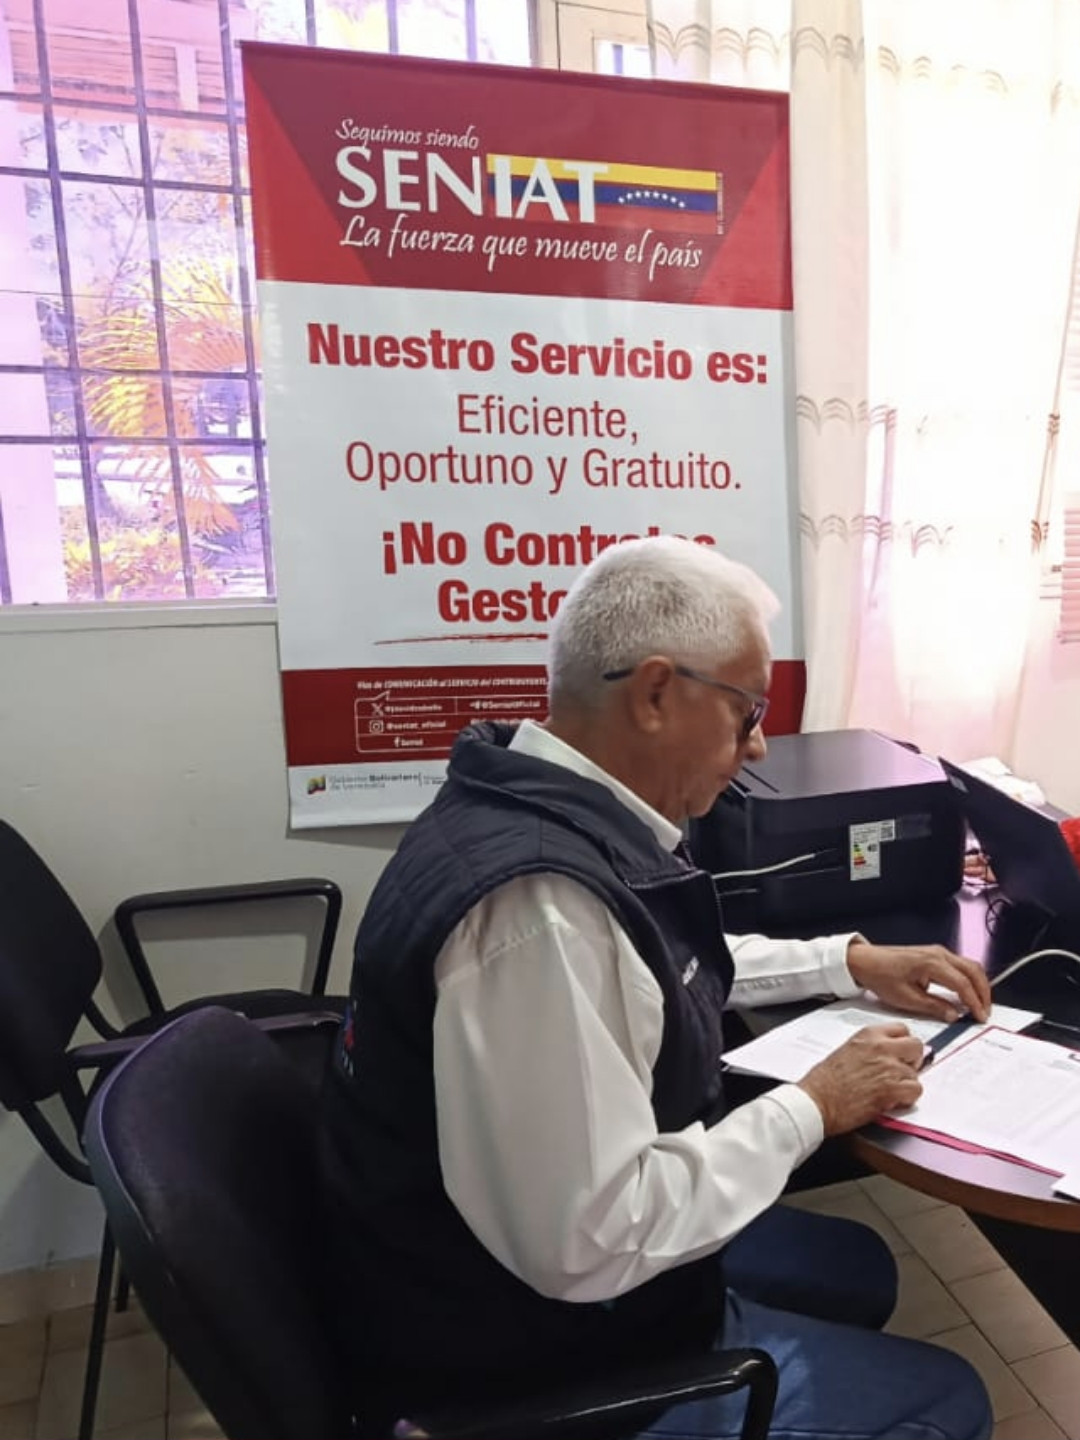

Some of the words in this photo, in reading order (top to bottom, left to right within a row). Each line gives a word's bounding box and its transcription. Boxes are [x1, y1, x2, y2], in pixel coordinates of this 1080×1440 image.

[336, 118, 422, 147] Seguimos
[427, 125, 479, 149] siendo
[335, 145, 608, 223] SENIAT
[340, 215, 380, 248] La
[387, 213, 474, 258] fuerza
[482, 235, 525, 271] que
[535, 238, 618, 263] mueve
[625, 229, 649, 264] el
[649, 242, 703, 281] país
[307, 322, 495, 371] Nuestro
[510, 331, 693, 380] Servicio
[707, 351, 768, 384] es:
[457, 393, 638, 444] Eficiente,
[345, 441, 534, 490] Oportuno
[546, 456, 568, 495] y
[583, 448, 742, 490] Gratuito.
[382, 521, 467, 574] ¡No
[484, 522, 716, 566] Contr
